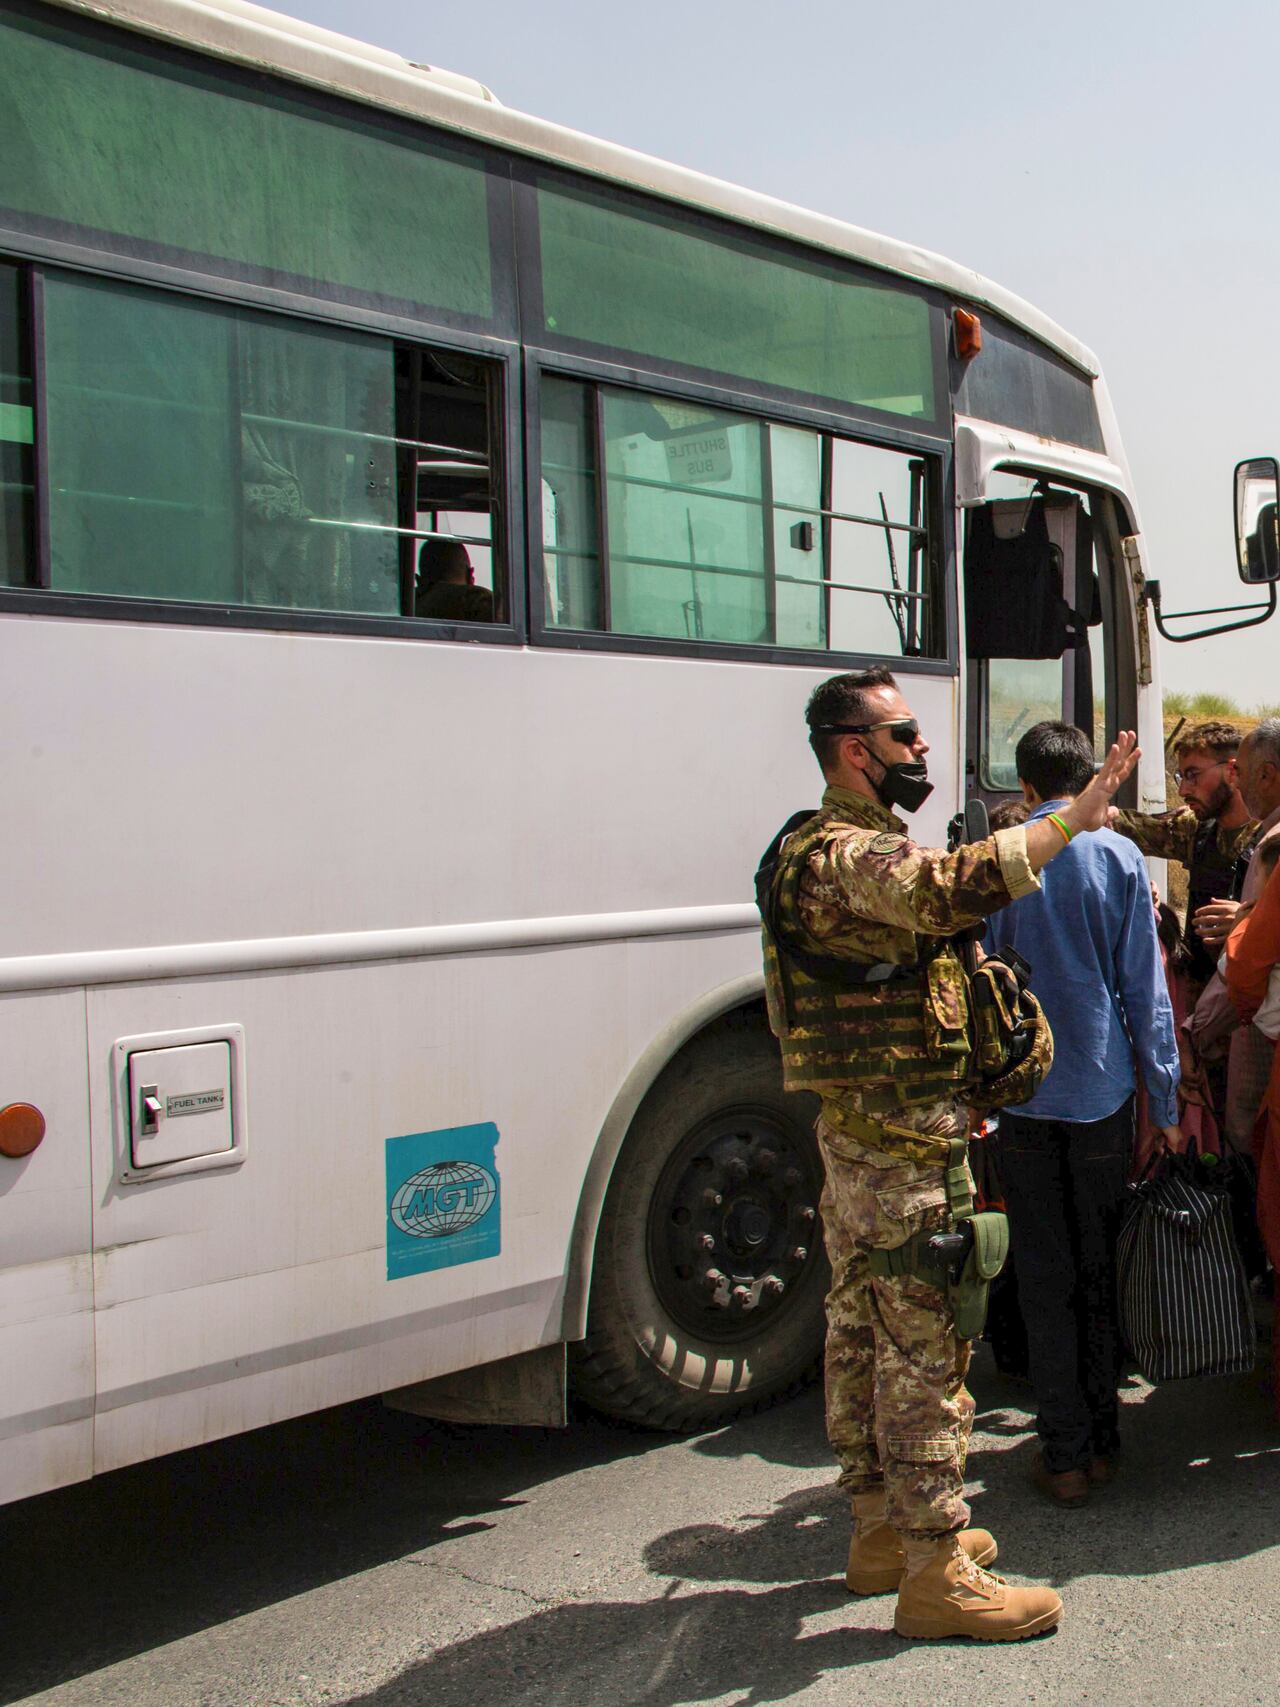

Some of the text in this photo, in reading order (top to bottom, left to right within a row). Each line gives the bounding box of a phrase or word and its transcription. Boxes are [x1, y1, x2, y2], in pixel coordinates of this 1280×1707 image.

[174, 1095, 219, 1108] FUEL TANK
[402, 1178, 484, 1219] MGT
